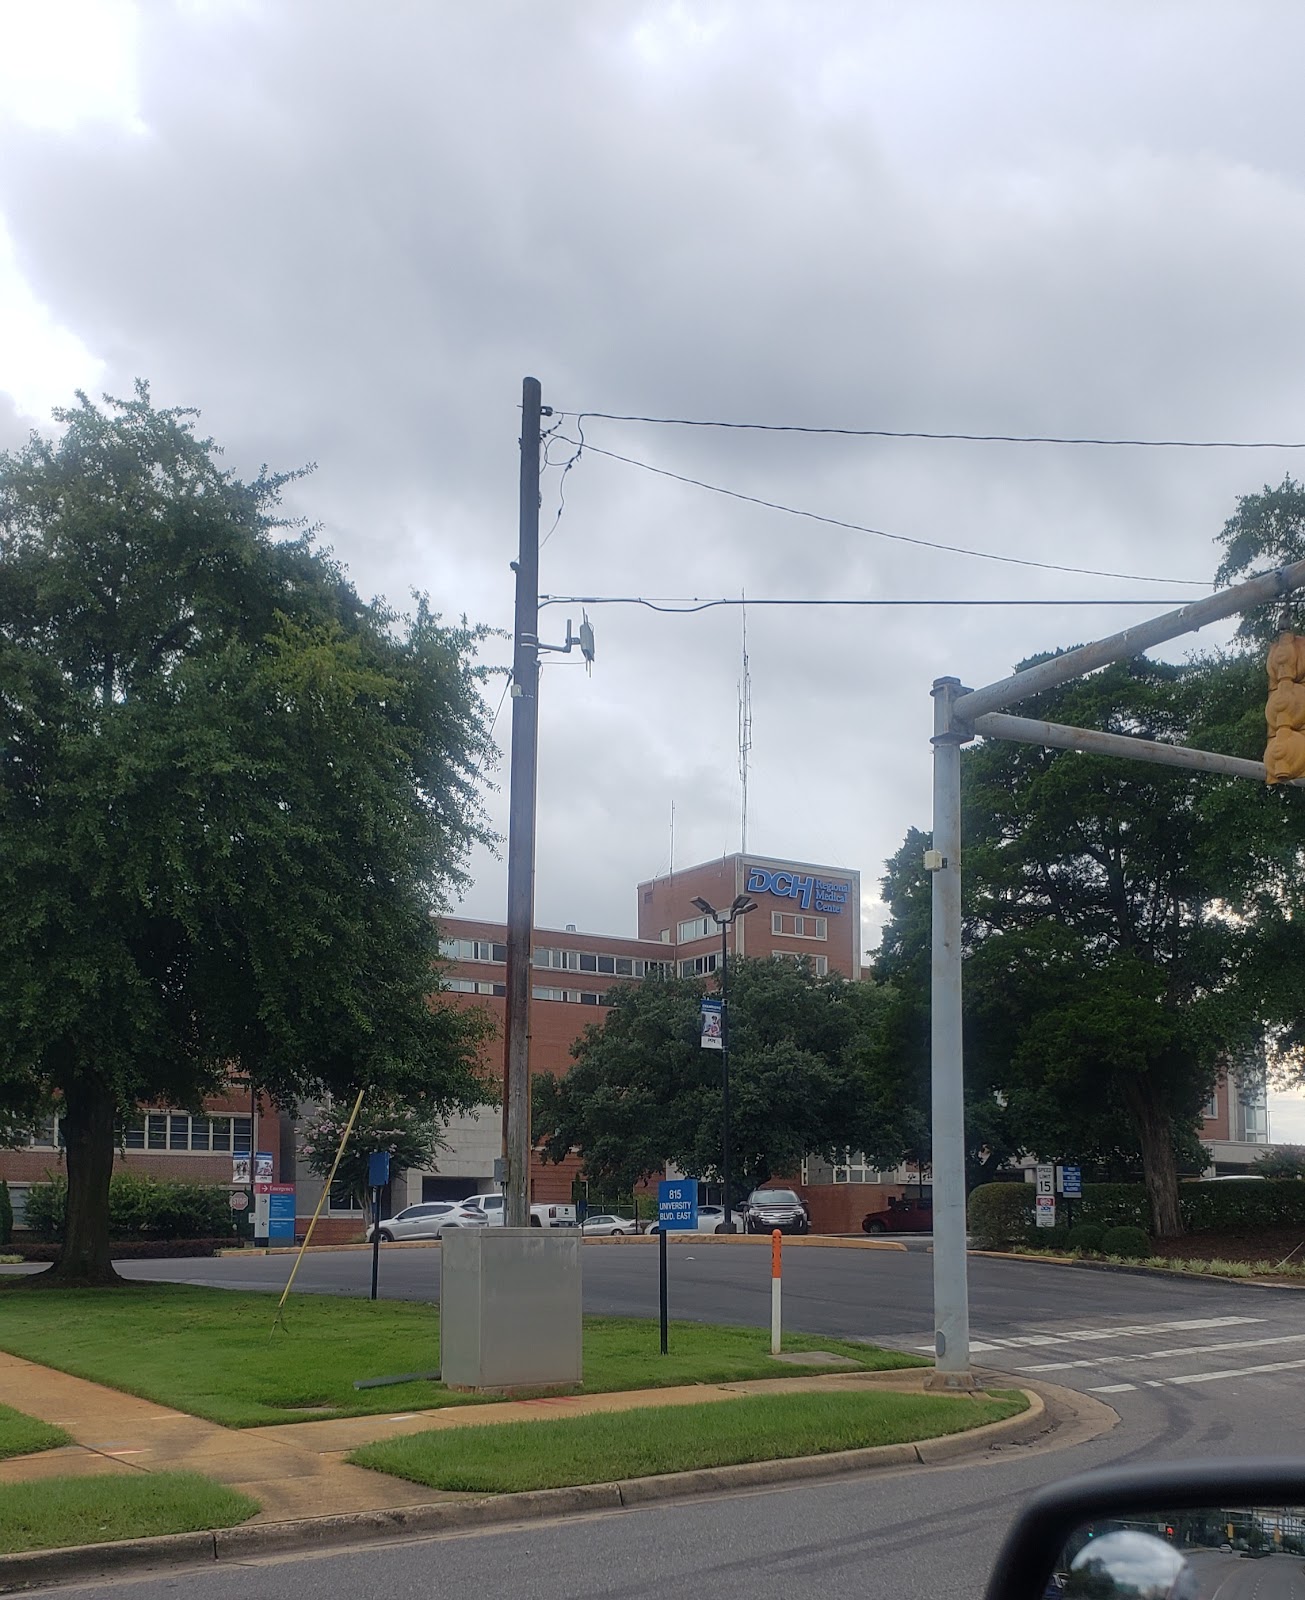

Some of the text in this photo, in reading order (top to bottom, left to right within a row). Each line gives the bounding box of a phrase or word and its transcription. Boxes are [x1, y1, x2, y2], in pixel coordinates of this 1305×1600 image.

[748, 867, 814, 909] DCH
[816, 881, 850, 892] Regional
[816, 890, 847, 902] Medical
[816, 901, 843, 912] Center
[1040, 1181, 1051, 1192] 15
[669, 1189, 682, 1200] 815
[659, 1202, 691, 1210] UNIVERSITY
[660, 1212, 675, 1220] BLVD.
